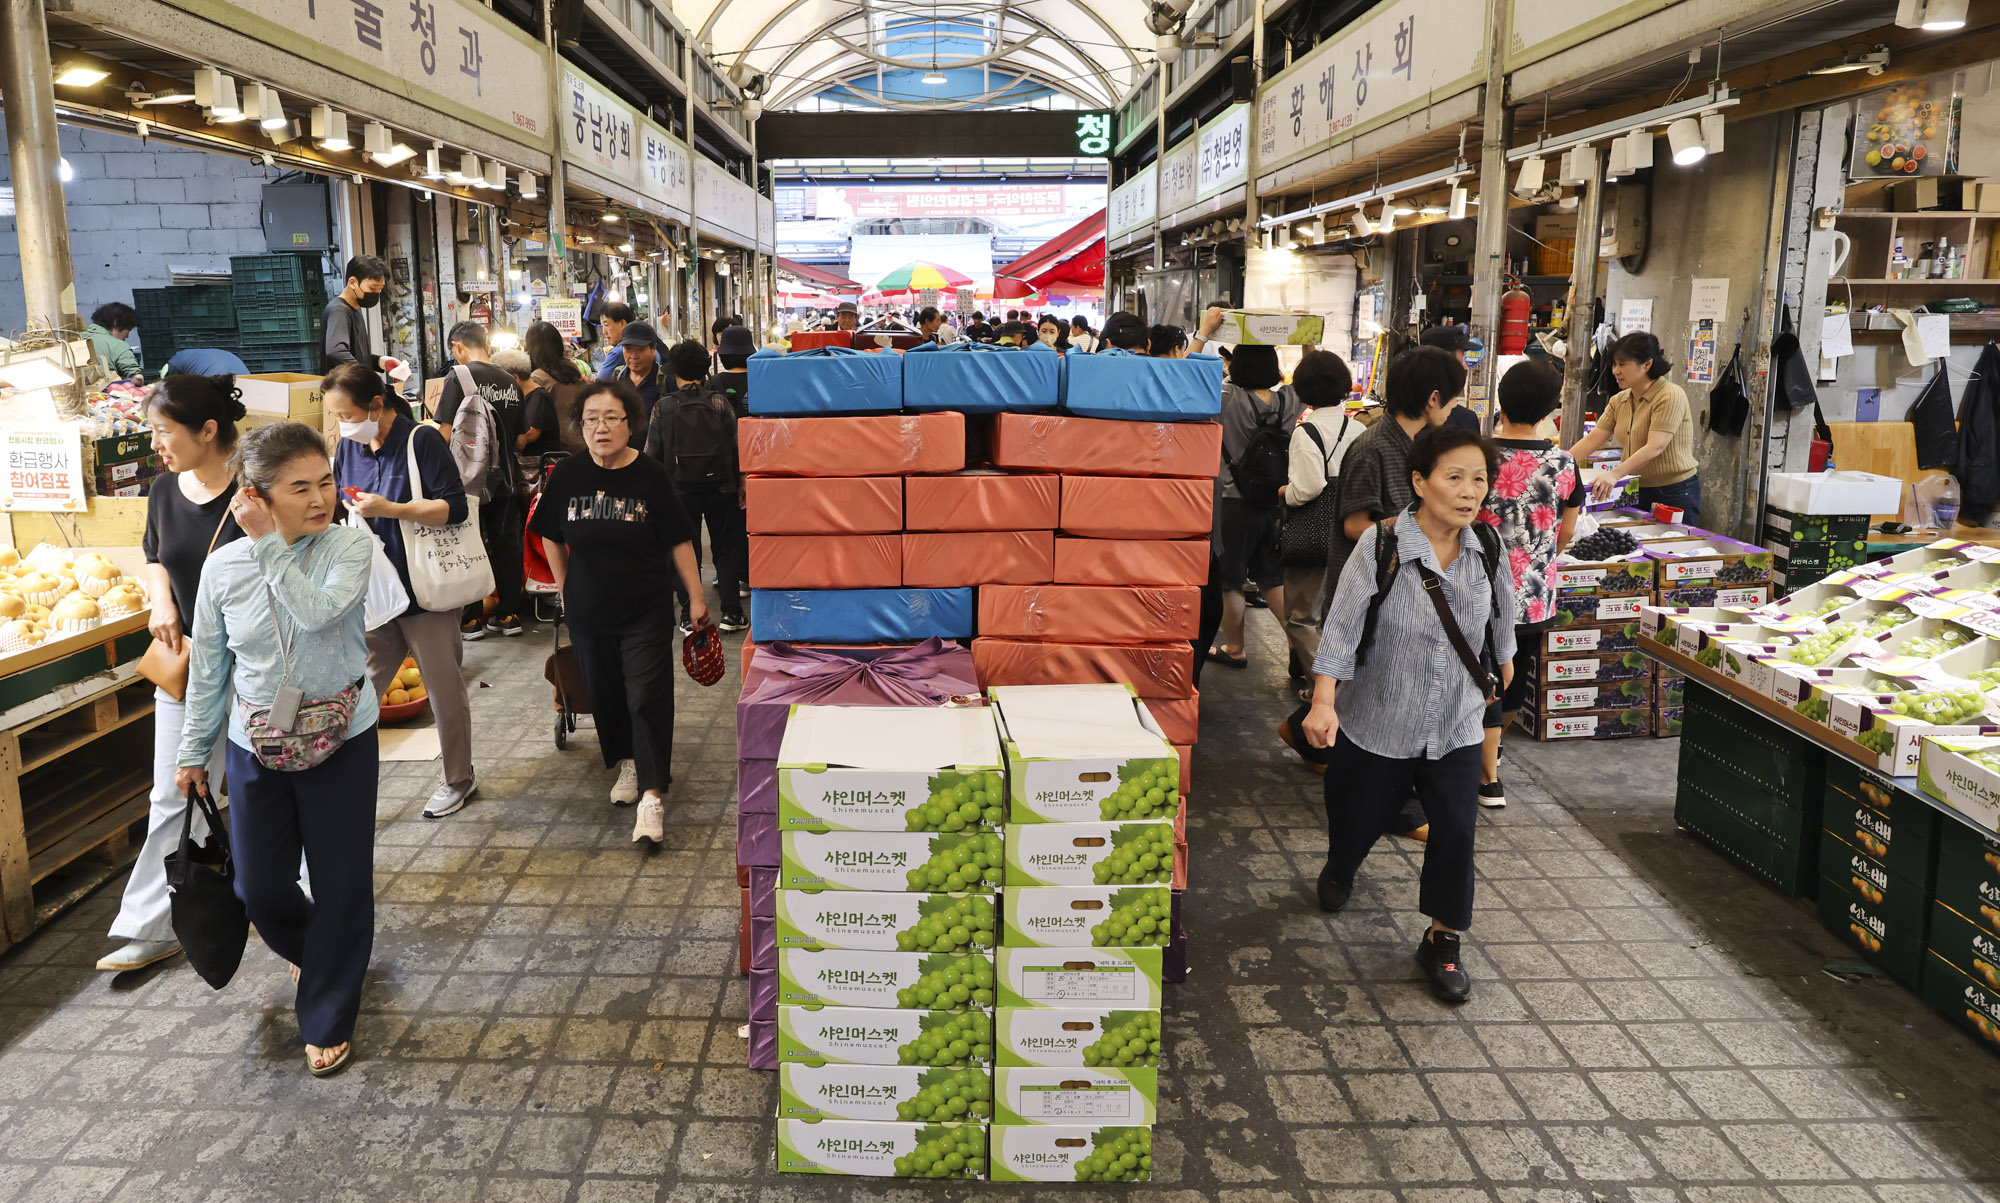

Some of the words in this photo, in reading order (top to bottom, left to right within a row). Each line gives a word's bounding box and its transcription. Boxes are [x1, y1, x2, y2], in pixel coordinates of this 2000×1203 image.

[1290, 14, 1415, 137] 황해상회
[572, 90, 631, 168] 풍남상회
[1075, 114, 1111, 154] 청
[549, 320, 576, 328] 여점포
[9, 451, 69, 470] 환급행사
[10, 471, 70, 490] 참여점포
[1696, 566, 1711, 574] 포도
[1575, 636, 1592, 645] 포도
[1574, 666, 1591, 674] 포도
[1573, 694, 1589, 702] 포도
[1573, 723, 1589, 731] 포도
[822, 790, 906, 807] 샤인머스켓
[1035, 789, 1094, 803] 샤인머스켓
[832, 807, 895, 815] Shinemuscat
[824, 850, 907, 867] 샤인머스켓
[1028, 853, 1087, 866] 샤인머스켓
[834, 867, 896, 875] Shinemuscat
[815, 912, 897, 928] 샤인머스켓
[1027, 916, 1086, 928] 샤인머스켓
[825, 928, 886, 936] Shinemuscat
[817, 969, 898, 986] 샤인머스켓
[827, 985, 887, 993] Shinemuscat
[819, 1027, 898, 1043] 샤인머스켓
[828, 1041, 888, 1049] Shinemuscat
[1020, 1037, 1078, 1049] 샤인머스켓
[818, 1084, 897, 1100] 샤인머스켓
[828, 1099, 887, 1107] Shinemuscat
[816, 1138, 895, 1155] 샤인머스켓
[826, 1153, 885, 1161] Shinemuscat
[1013, 1153, 1069, 1164] 샤인머스켓
